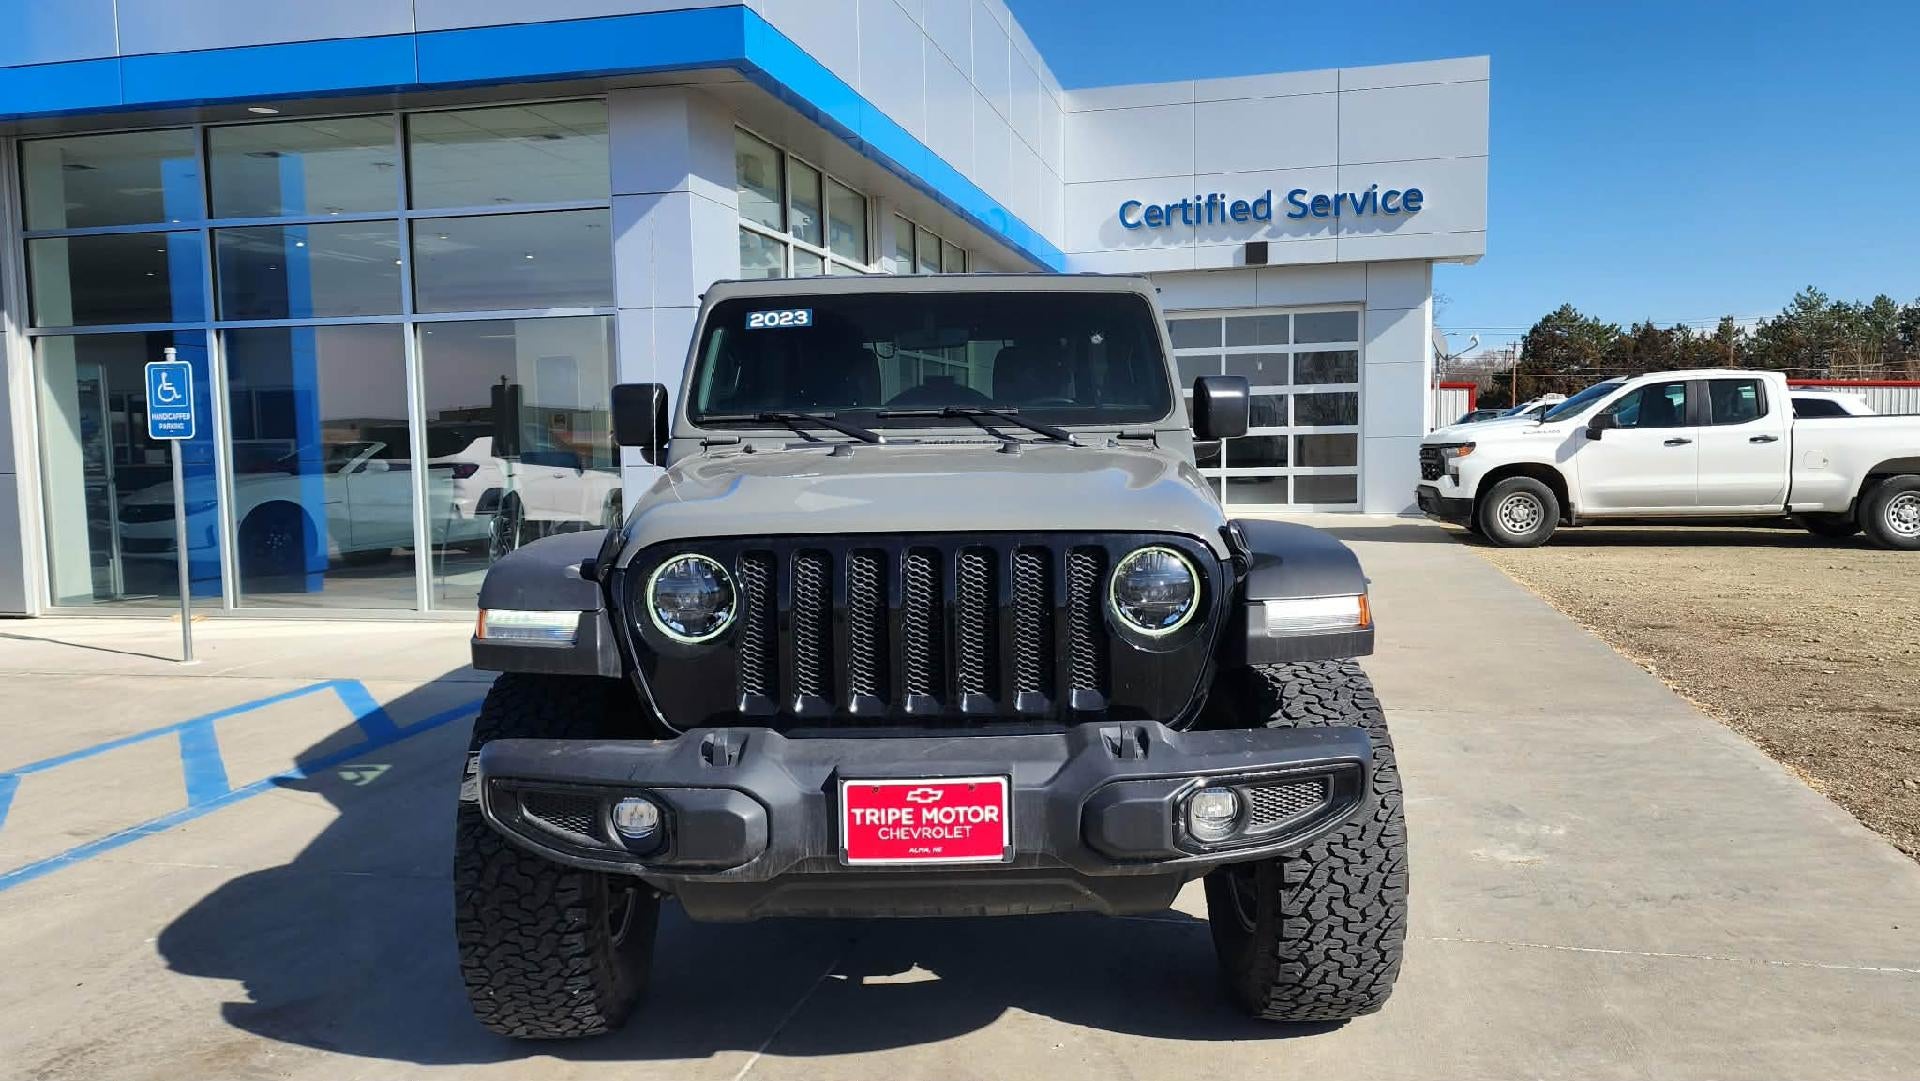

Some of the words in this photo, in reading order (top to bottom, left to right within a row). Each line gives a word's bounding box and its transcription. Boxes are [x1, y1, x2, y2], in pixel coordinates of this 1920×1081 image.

[1119, 189, 1272, 229] Certified
[1287, 183, 1424, 219] Service
[749, 311, 809, 327] 2023
[158, 422, 185, 430] PARKING
[851, 808, 914, 825] TRIPE
[922, 805, 999, 824] MOTOR
[877, 825, 972, 840] CHEVROLET
